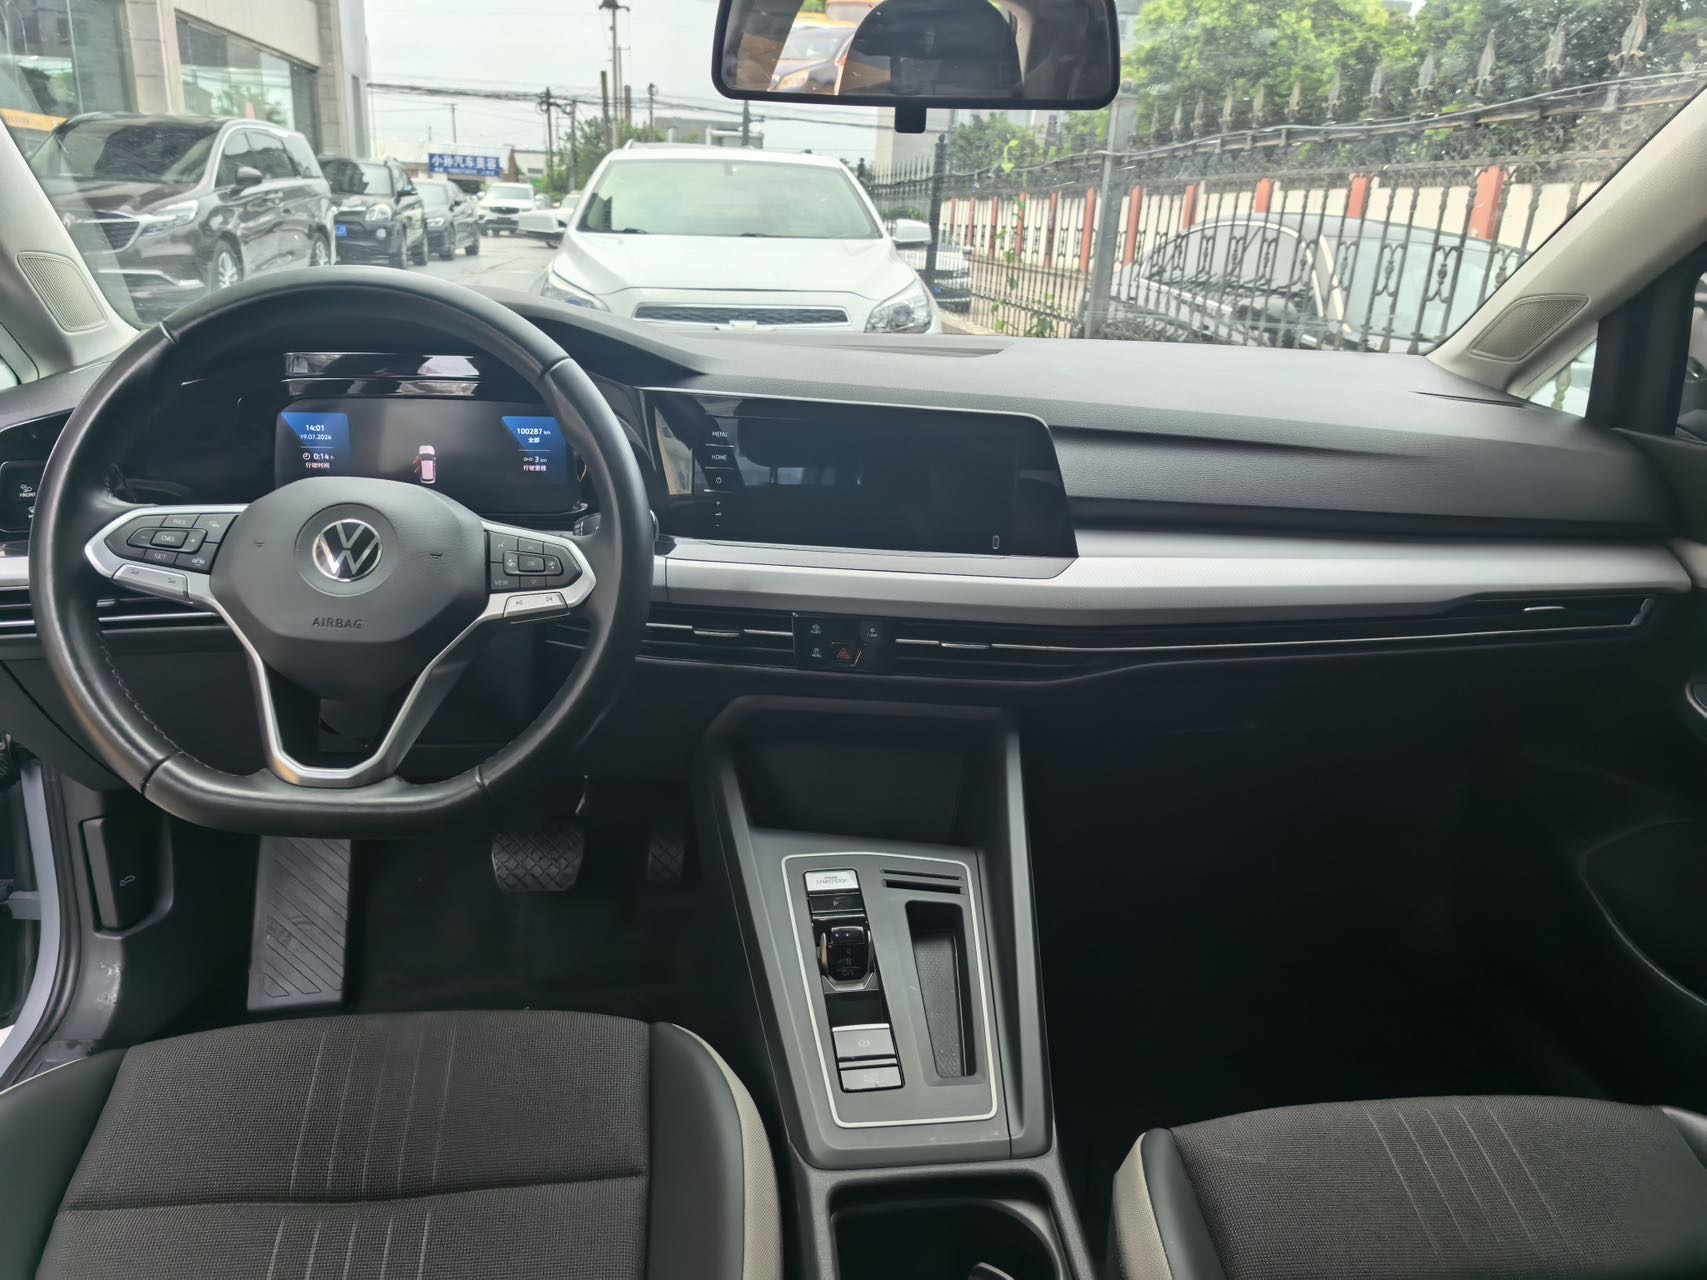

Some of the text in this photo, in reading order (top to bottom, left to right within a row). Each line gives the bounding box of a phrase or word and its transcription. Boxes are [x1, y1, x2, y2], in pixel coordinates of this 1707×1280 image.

[517, 427, 543, 435] 100287
[173, 518, 186, 526] RES
[154, 552, 167, 560] SET
[311, 617, 363, 630] AIRBAG
